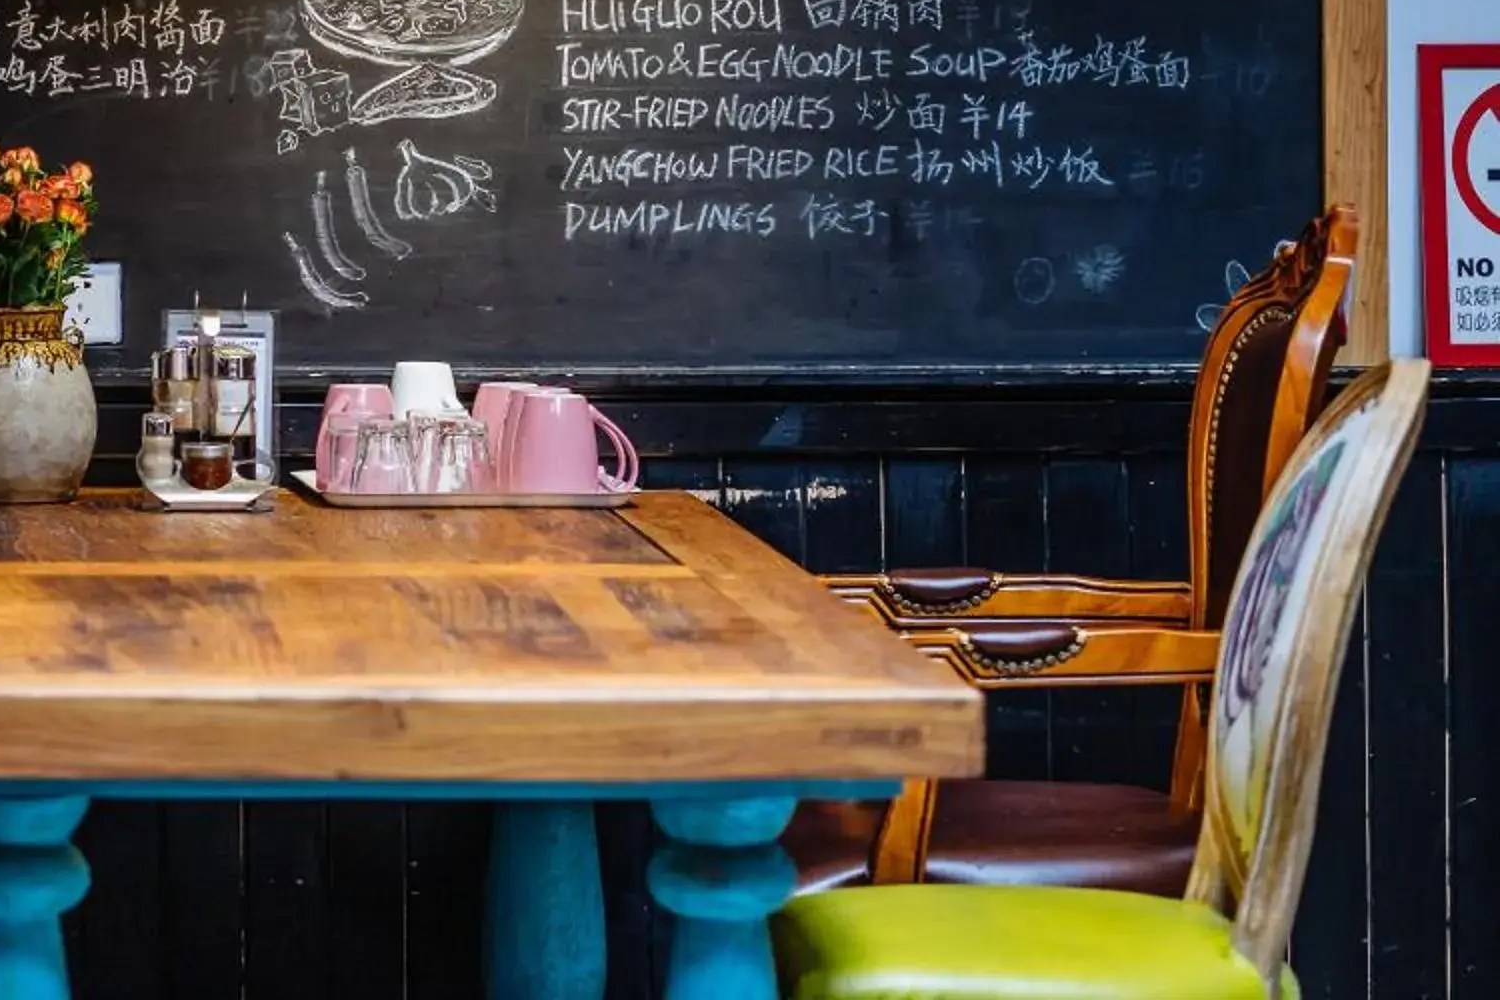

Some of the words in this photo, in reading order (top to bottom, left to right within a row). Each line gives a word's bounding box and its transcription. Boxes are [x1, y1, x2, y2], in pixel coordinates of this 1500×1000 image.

[771, 43, 894, 82] NOODLE
[561, 95, 709, 132] STIR-FRIED
[714, 93, 836, 131] NOODLES
[855, 88, 946, 134] 炒面
[560, 147, 719, 191] YANGCHOW
[726, 145, 814, 179] FRIED
[823, 146, 900, 180] RICE
[906, 138, 1116, 188] 扬州炒饭
[564, 200, 777, 240] DUMPLINGS
[798, 193, 890, 240] 饺子
[1456, 257, 1494, 278] NO
